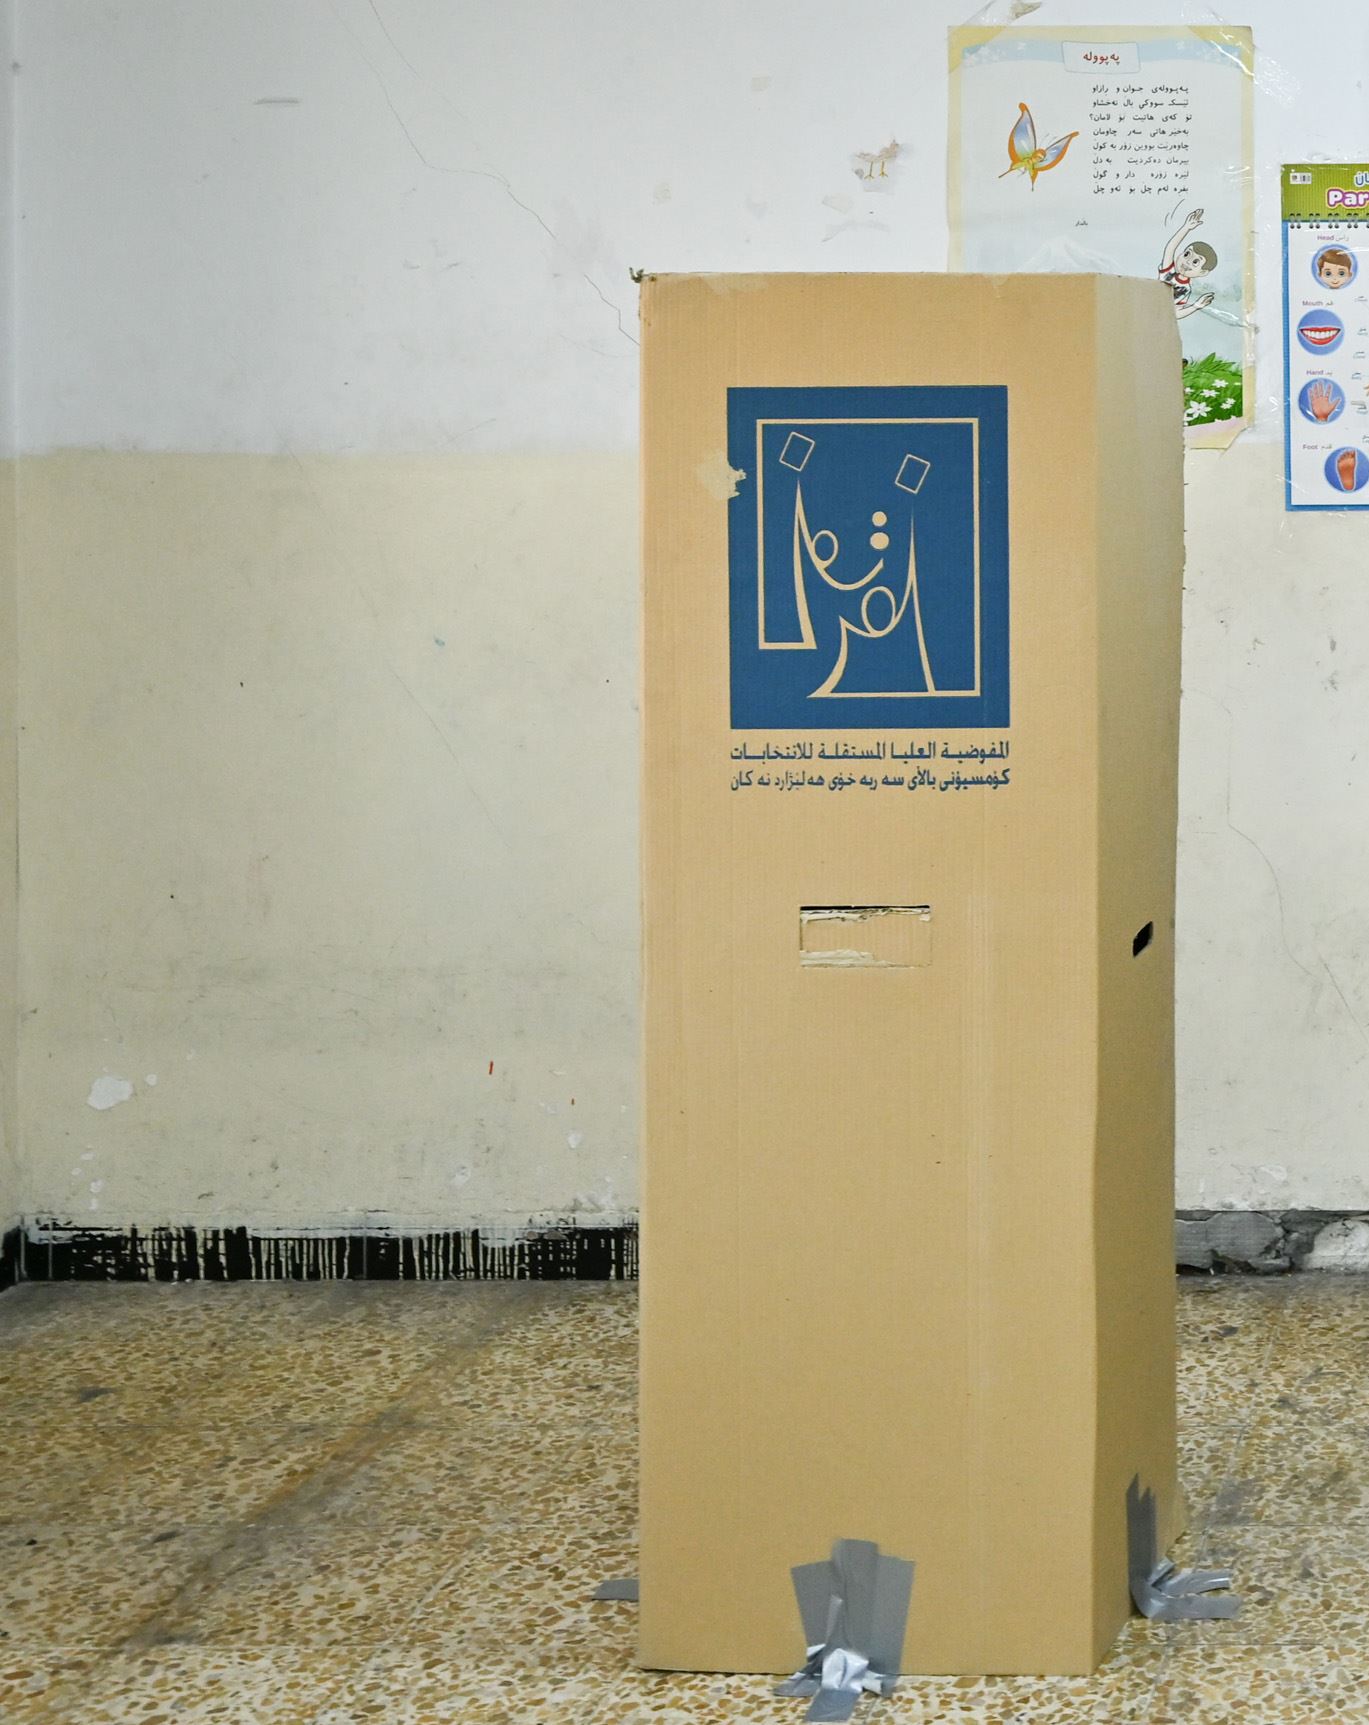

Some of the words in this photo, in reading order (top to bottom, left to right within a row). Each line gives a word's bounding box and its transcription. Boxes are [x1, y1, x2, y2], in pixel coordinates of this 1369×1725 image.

[730, 742, 813, 765] للانتخابات
[818, 741, 886, 760] المستقلة
[891, 741, 936, 764] العليا
[941, 740, 1009, 764] المفوضية
